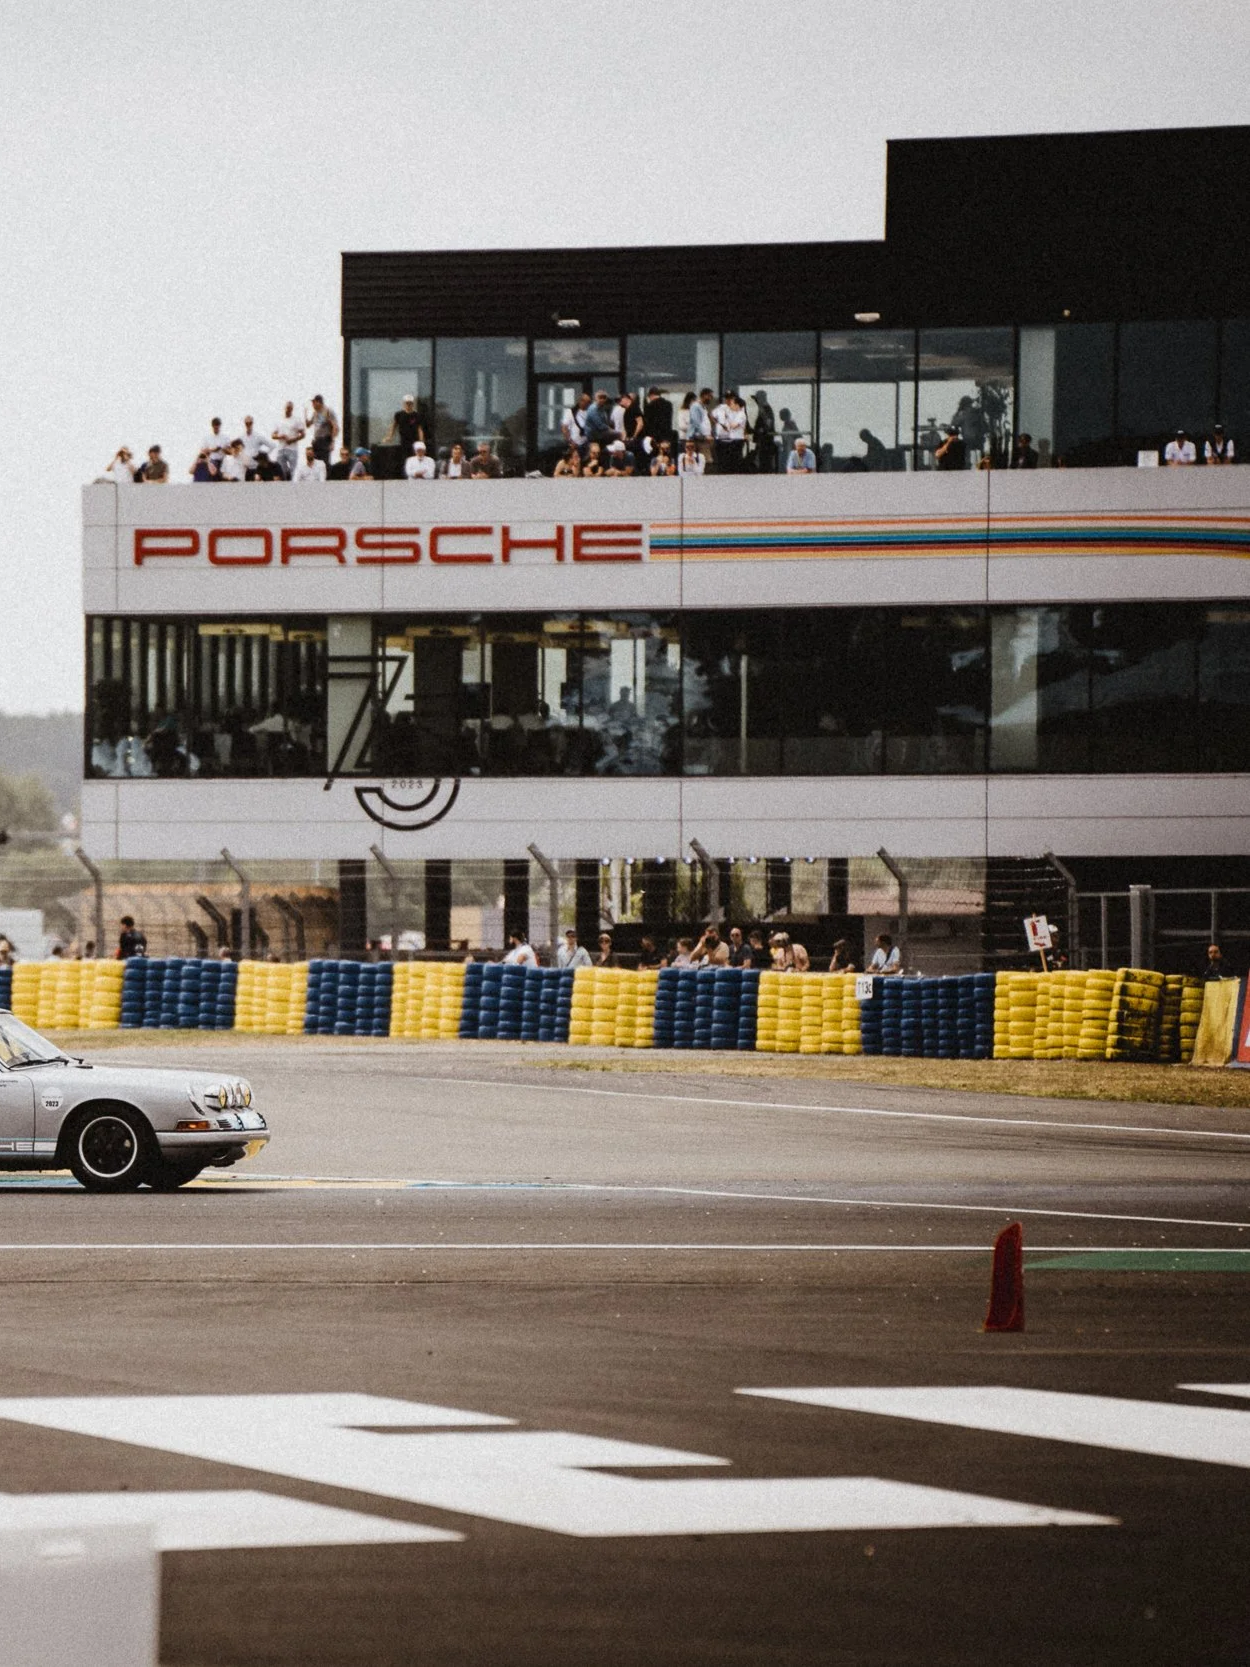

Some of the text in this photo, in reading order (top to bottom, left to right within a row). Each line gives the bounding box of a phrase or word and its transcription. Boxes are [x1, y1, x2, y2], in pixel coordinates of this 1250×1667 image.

[133, 523, 643, 567] PORSCHE
[391, 779, 423, 789] 2023
[45, 1100, 59, 1108] 2023
